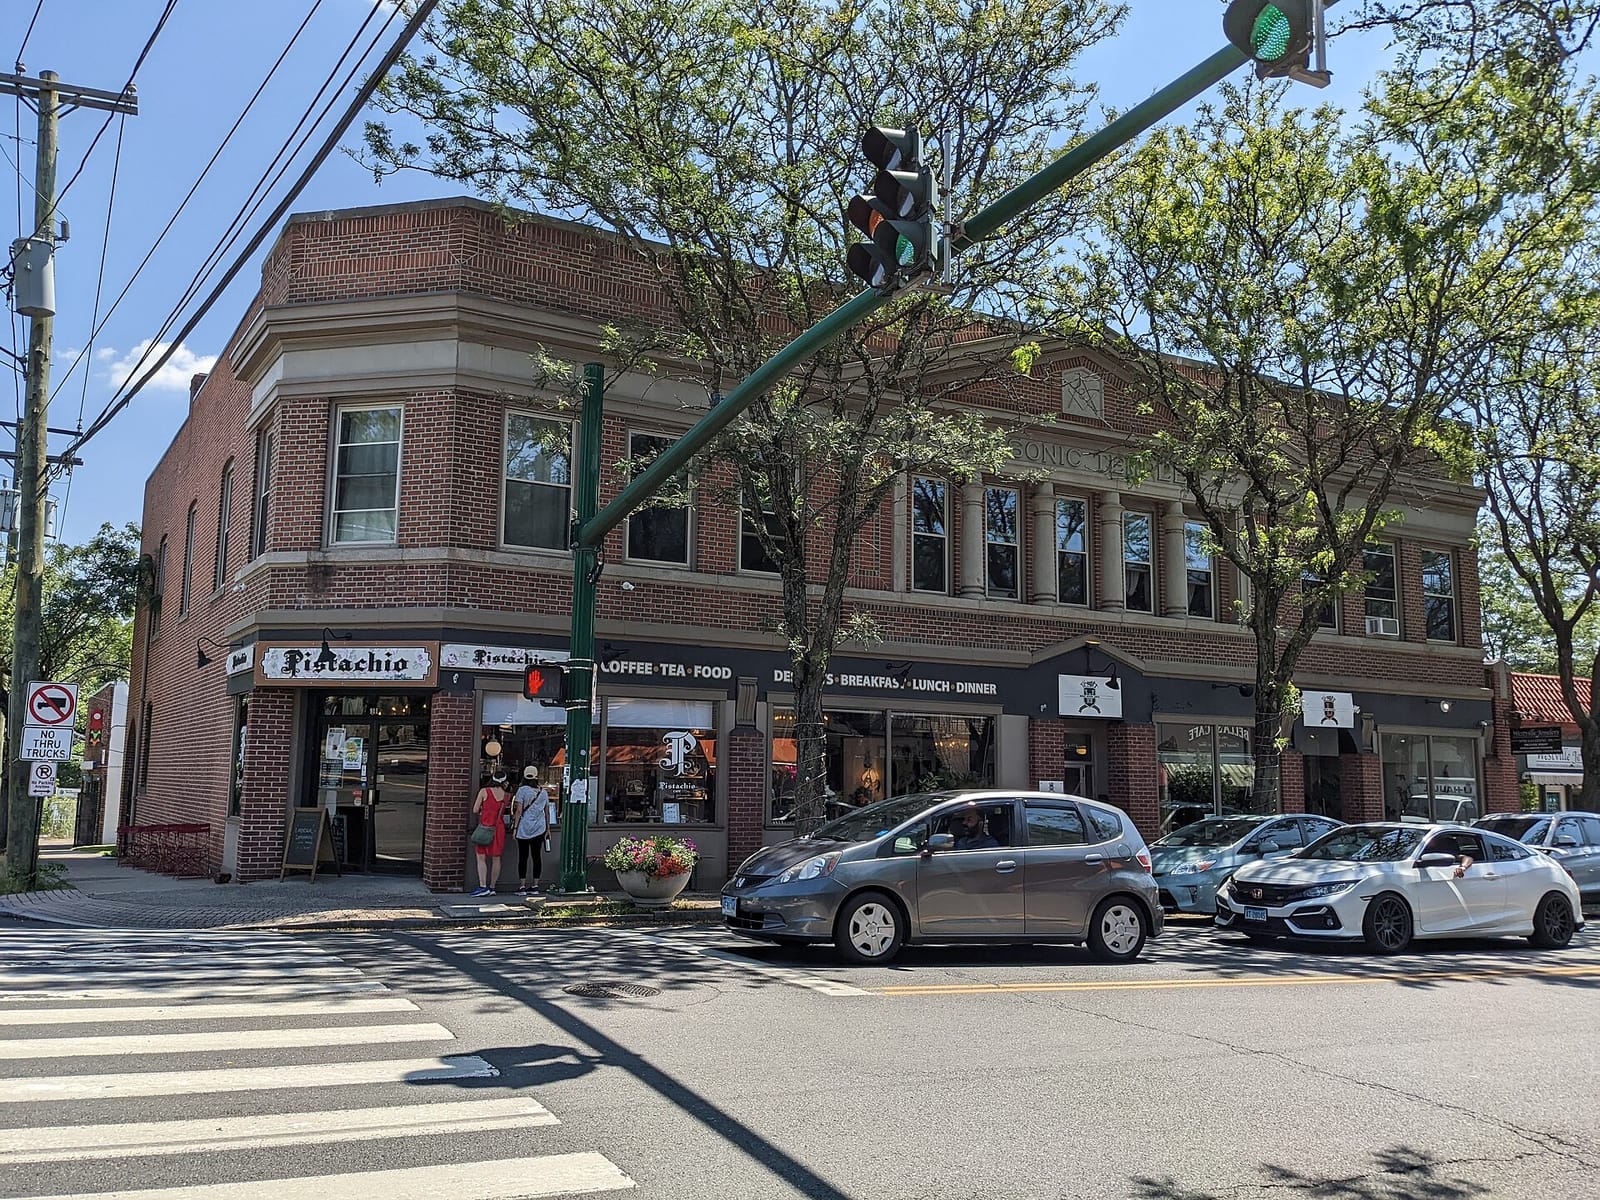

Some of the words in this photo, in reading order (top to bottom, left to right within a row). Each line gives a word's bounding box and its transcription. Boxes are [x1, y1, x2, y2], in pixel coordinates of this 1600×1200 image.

[281, 649, 409, 677] Pistachio
[659, 663, 686, 677] TEA
[693, 665, 732, 679] FOOD
[912, 678, 950, 693] LUNCH
[956, 682, 997, 695] DINNER
[40, 730, 55, 739] NO
[33, 739, 61, 749] THRU
[26, 748, 65, 758] TRUCKS
[659, 781, 696, 790] Pistachio
